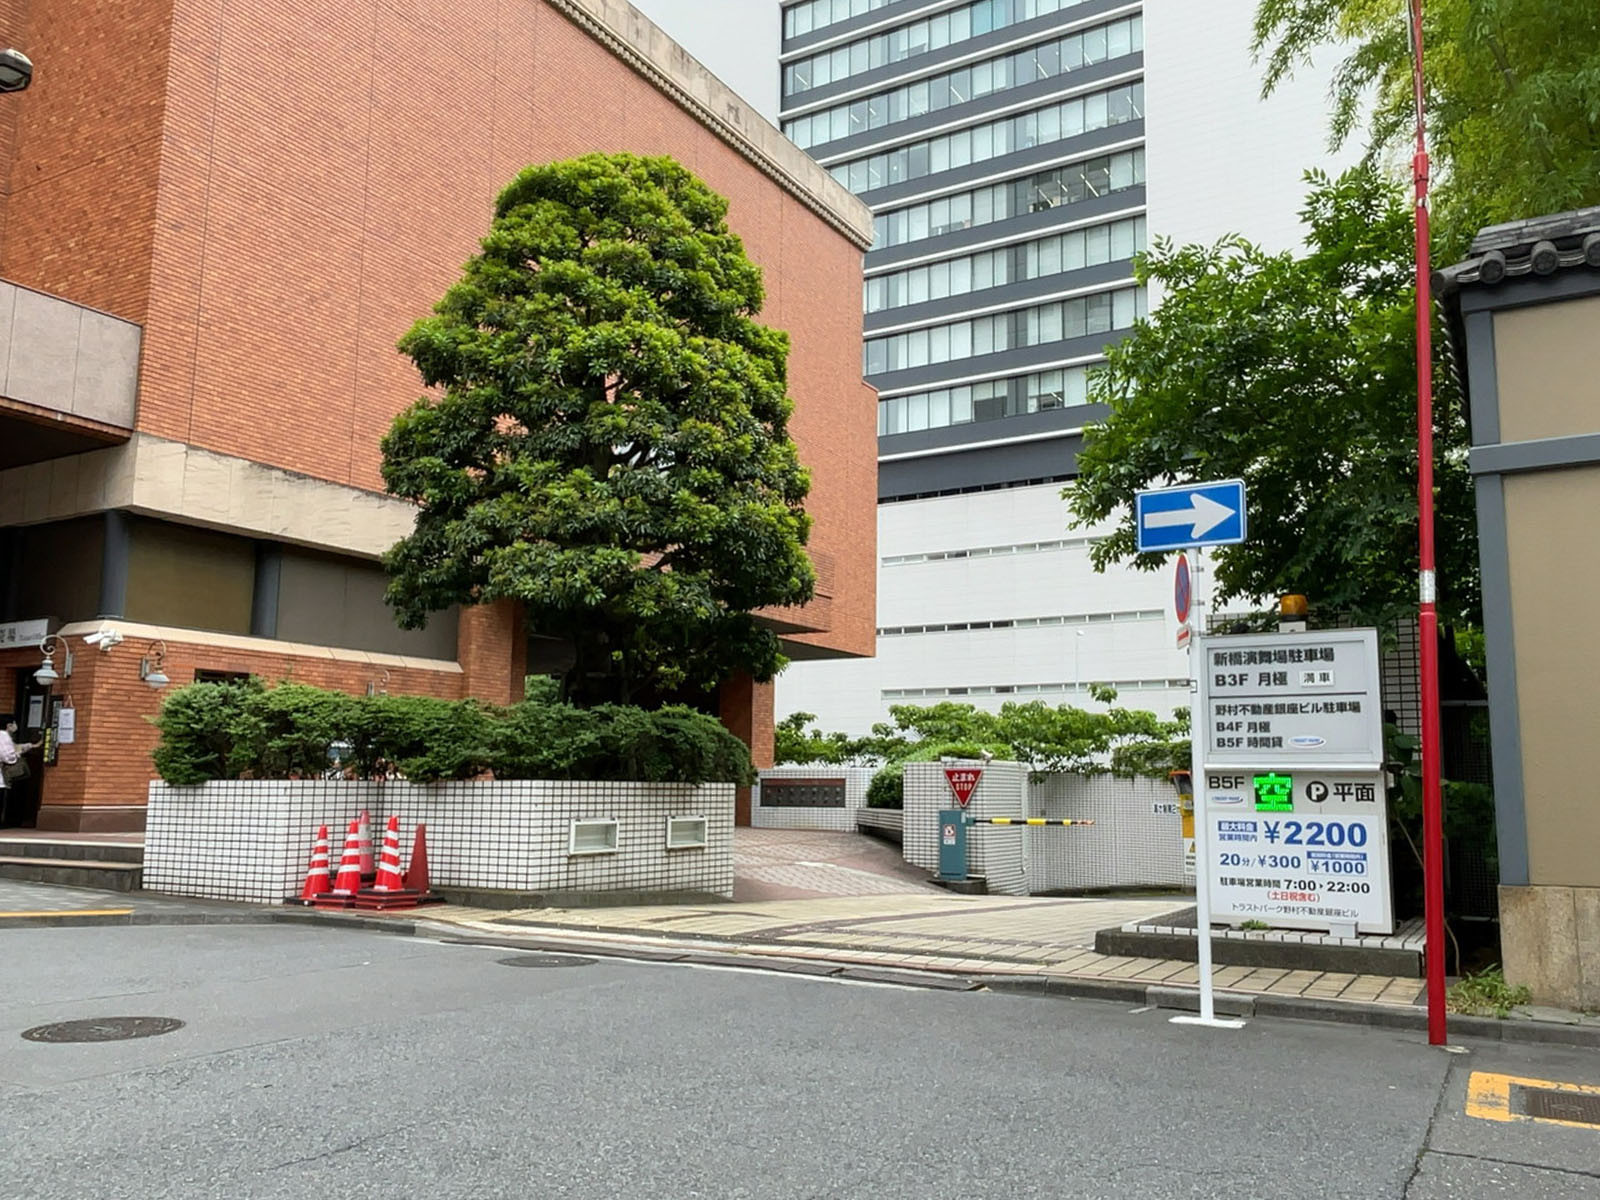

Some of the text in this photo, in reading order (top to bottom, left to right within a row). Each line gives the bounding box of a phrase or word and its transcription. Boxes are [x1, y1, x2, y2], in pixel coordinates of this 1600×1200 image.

[1214, 647, 1335, 667] 新橋演舞場駐車場
[1215, 671, 1330, 687] B3F 月極 満車
[1215, 701, 1361, 716] 野村不動産銀座ビル駐車場
[1216, 721, 1271, 733] B4F 月極
[1216, 737, 1244, 748] B5F
[1247, 736, 1284, 748] 時間貸
[1208, 776, 1245, 789] B5F
[1253, 772, 1294, 812] 空
[1333, 782, 1376, 803] 平面
[1263, 820, 1367, 847] ¥2200
[1310, 860, 1365, 874] ¥1000
[1220, 877, 1370, 894] 駐車場営業時間 7:00 22:00
